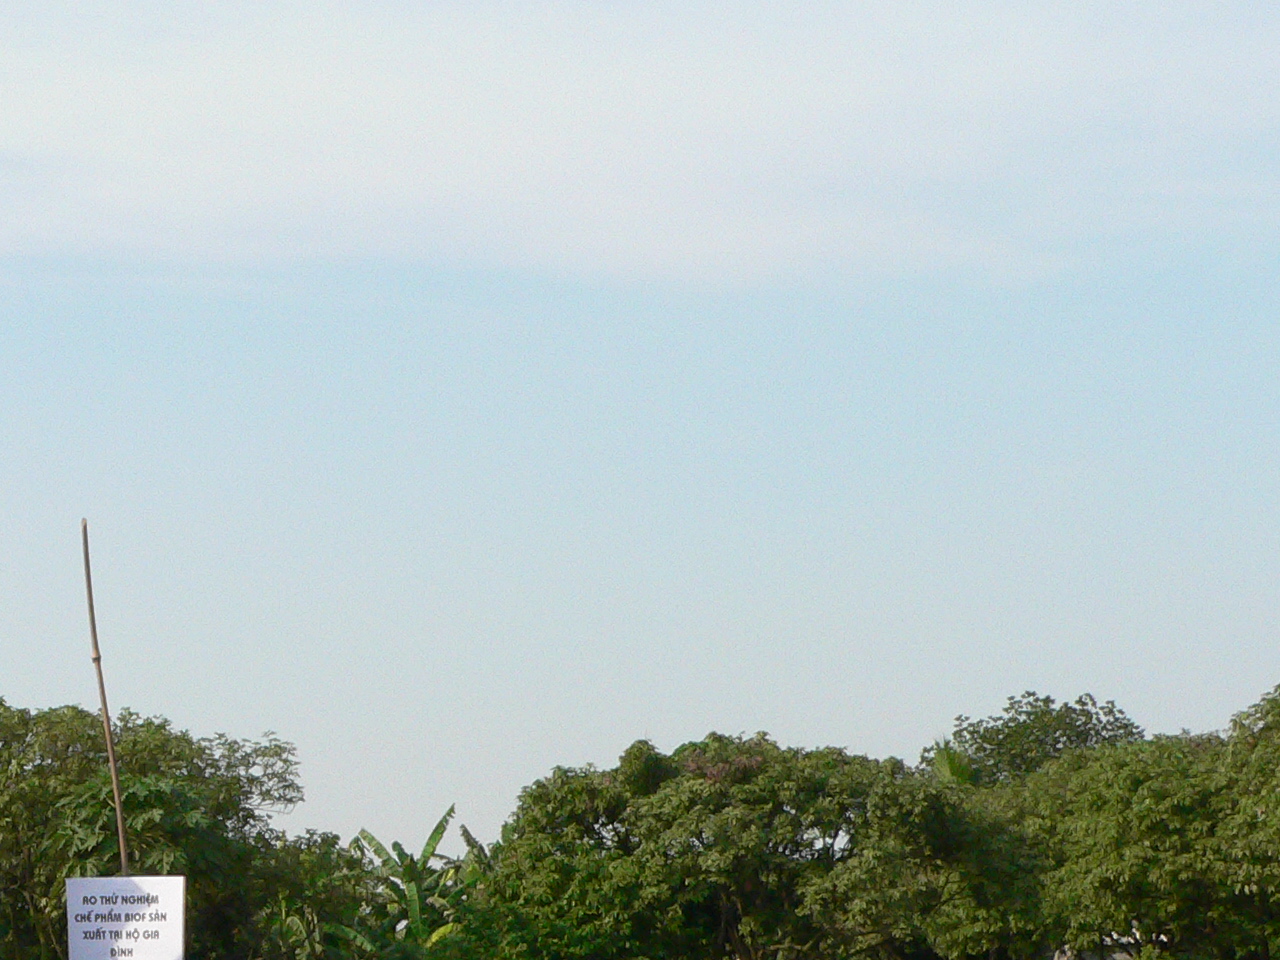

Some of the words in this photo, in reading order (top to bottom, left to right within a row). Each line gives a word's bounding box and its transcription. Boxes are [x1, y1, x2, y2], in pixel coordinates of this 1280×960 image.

[82, 895, 97, 906] AO
[124, 913, 146, 923] BIOF
[109, 930, 122, 942] TẠI
[126, 928, 140, 942] HỘ
[143, 930, 160, 939] GIA
